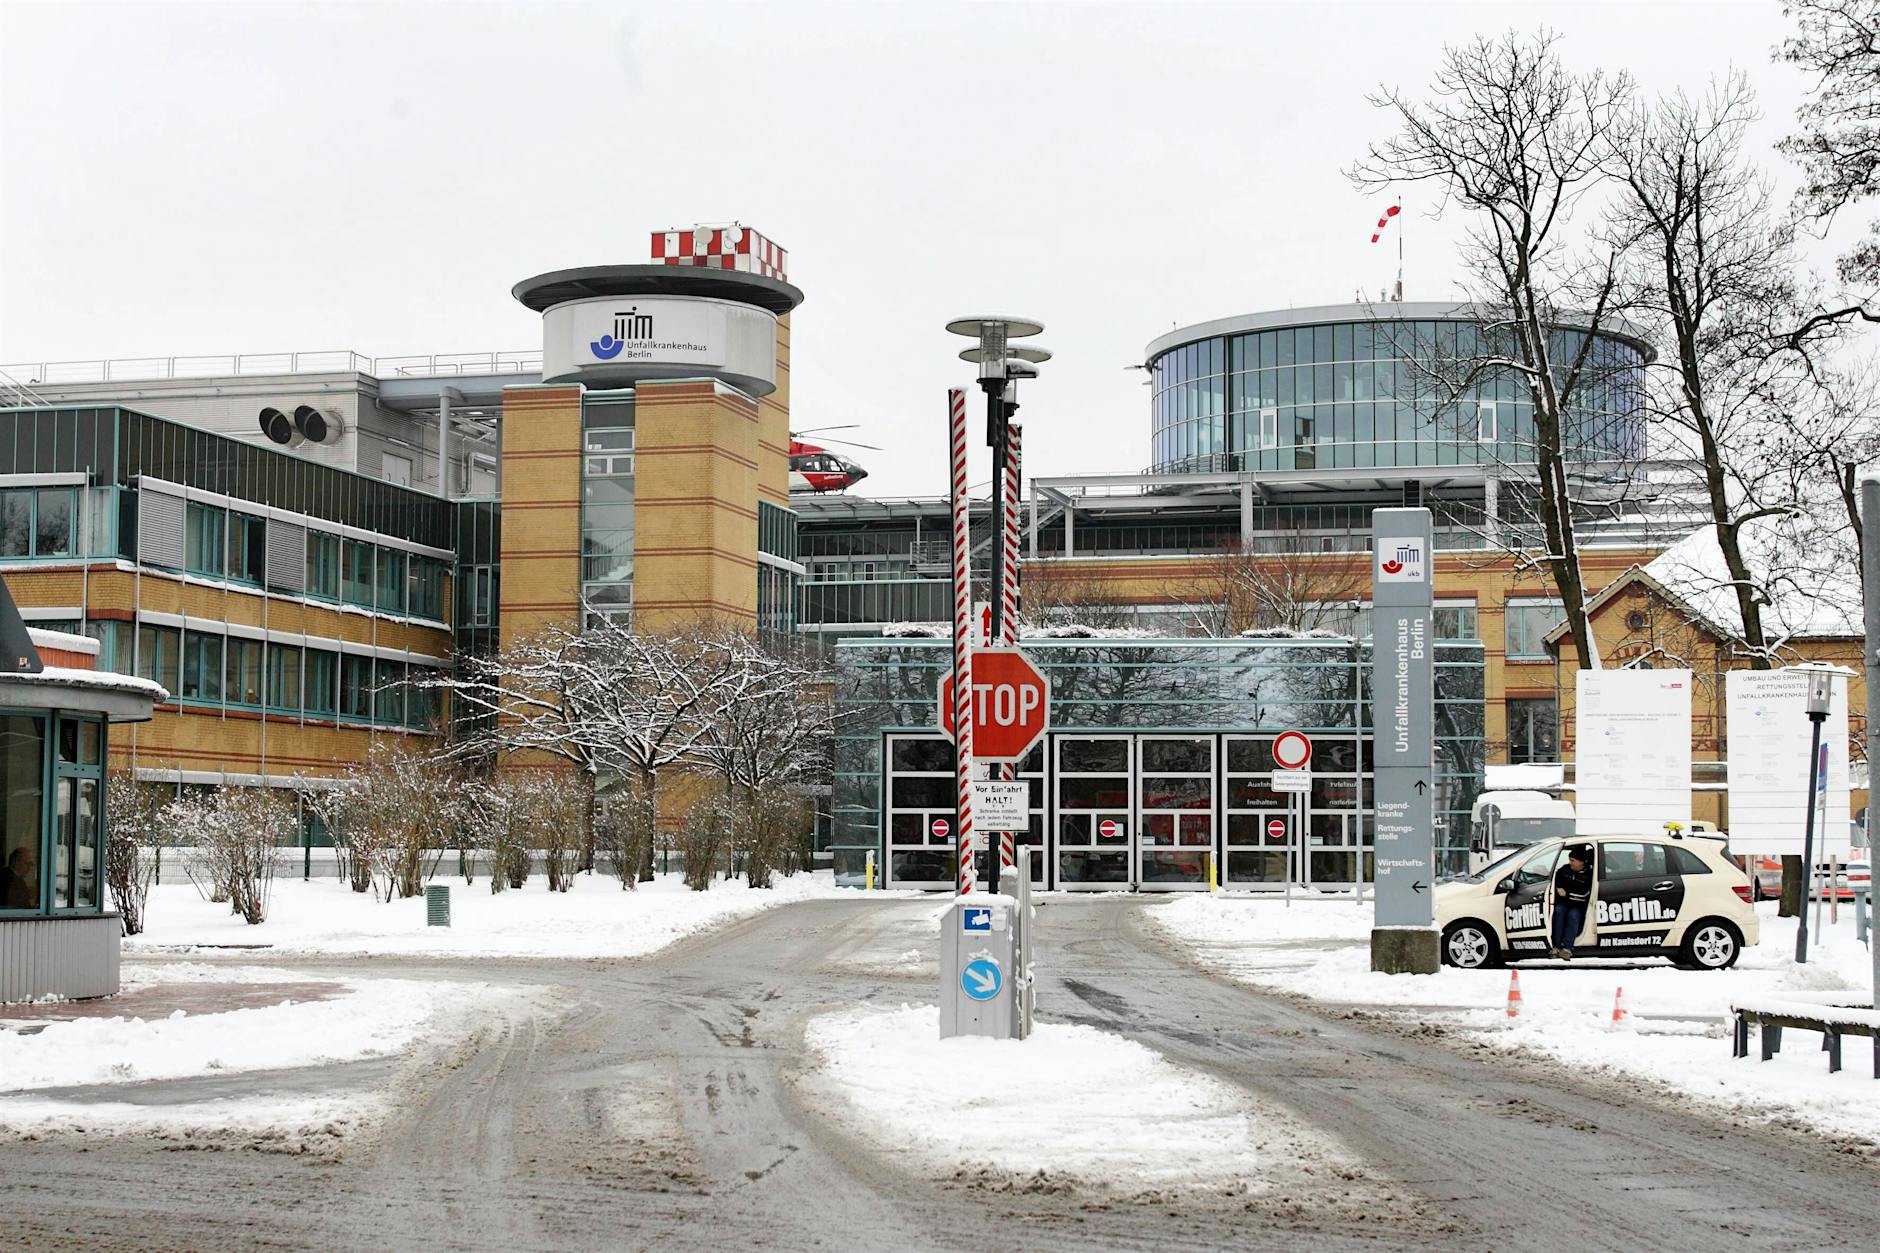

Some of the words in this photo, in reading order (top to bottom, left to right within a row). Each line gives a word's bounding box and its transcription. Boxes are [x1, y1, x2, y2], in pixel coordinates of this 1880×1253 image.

[627, 341, 707, 351] Unfallkrankenhaus
[627, 350, 652, 358] Berlin
[1411, 618, 1424, 659] Berlin
[1395, 618, 1408, 752] Unfallkrankenhaus
[951, 683, 1039, 727] TOP
[991, 785, 1022, 793] Einfahrt
[1377, 801, 1410, 811] Liegend-
[1377, 810, 1404, 818] kranke
[1377, 824, 1415, 834] Rettungs-
[1377, 833, 1399, 841] stelle
[1377, 859, 1425, 867] Wirtschafts-
[1377, 867, 1391, 875] hof
[1596, 897, 1676, 925] Berlin.de
[1600, 937, 1612, 947] Alt
[1612, 936, 1651, 947] Kaulsdorf
[1651, 936, 1662, 945] 72
